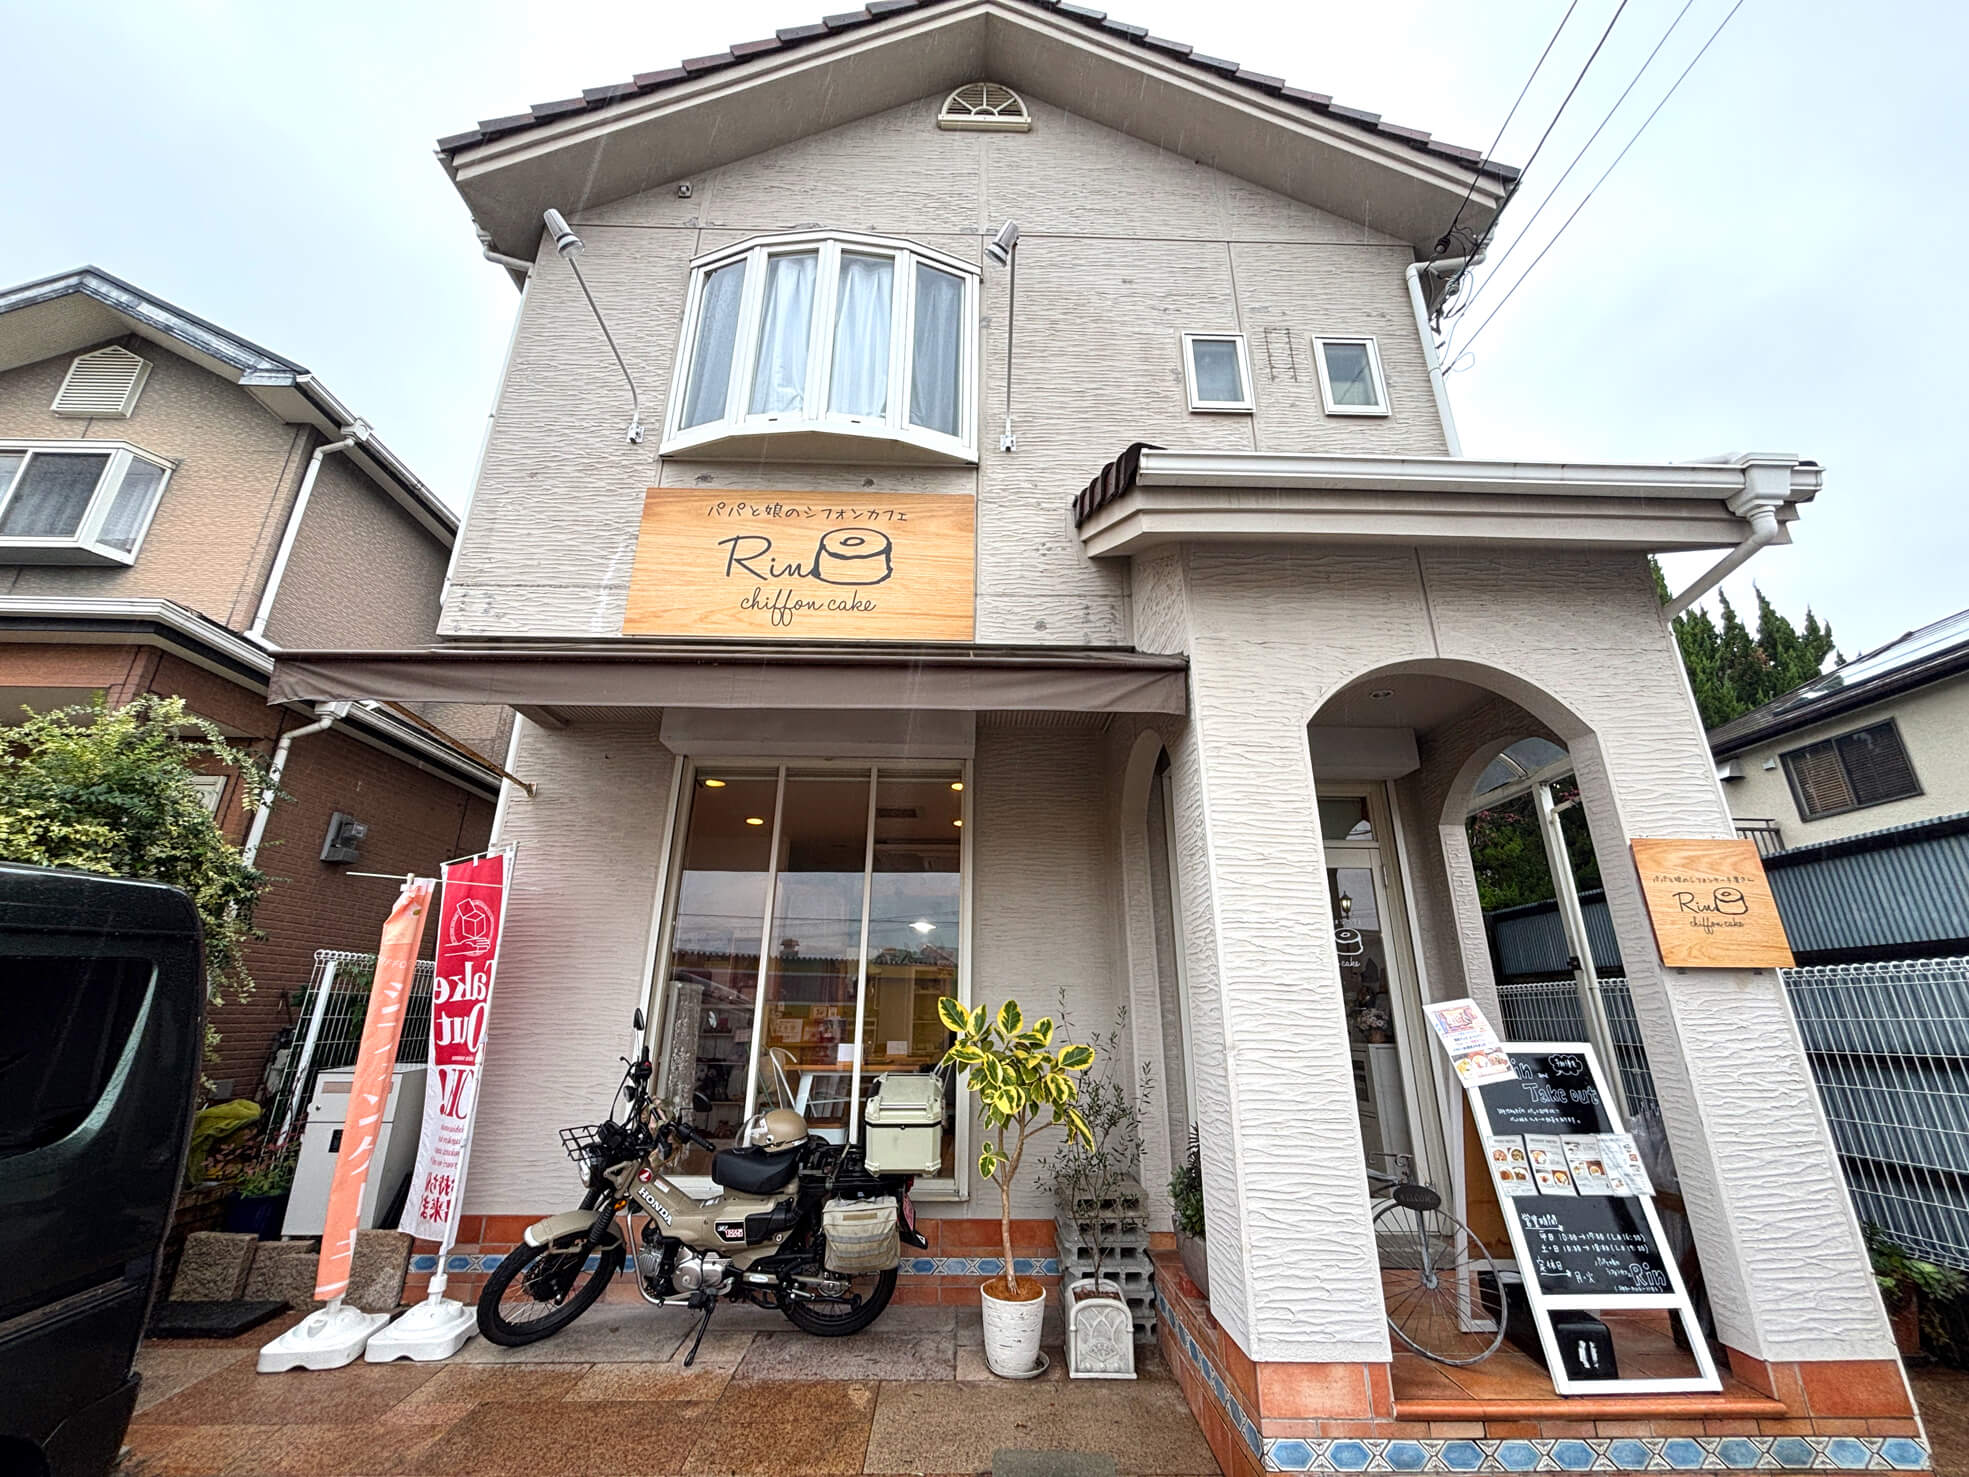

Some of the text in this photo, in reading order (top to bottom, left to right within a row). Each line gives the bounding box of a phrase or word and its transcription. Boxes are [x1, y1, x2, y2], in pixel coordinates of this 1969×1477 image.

[707, 502, 909, 522] パパと娘のシフォンカフェ
[718, 535, 815, 581] Rin
[740, 587, 877, 627] chiffon cake
[1672, 891, 1717, 914] Rin
[1521, 1082, 1599, 1105] Take out
[638, 1187, 672, 1227] HONDA
[1628, 1261, 1667, 1287] Rin
